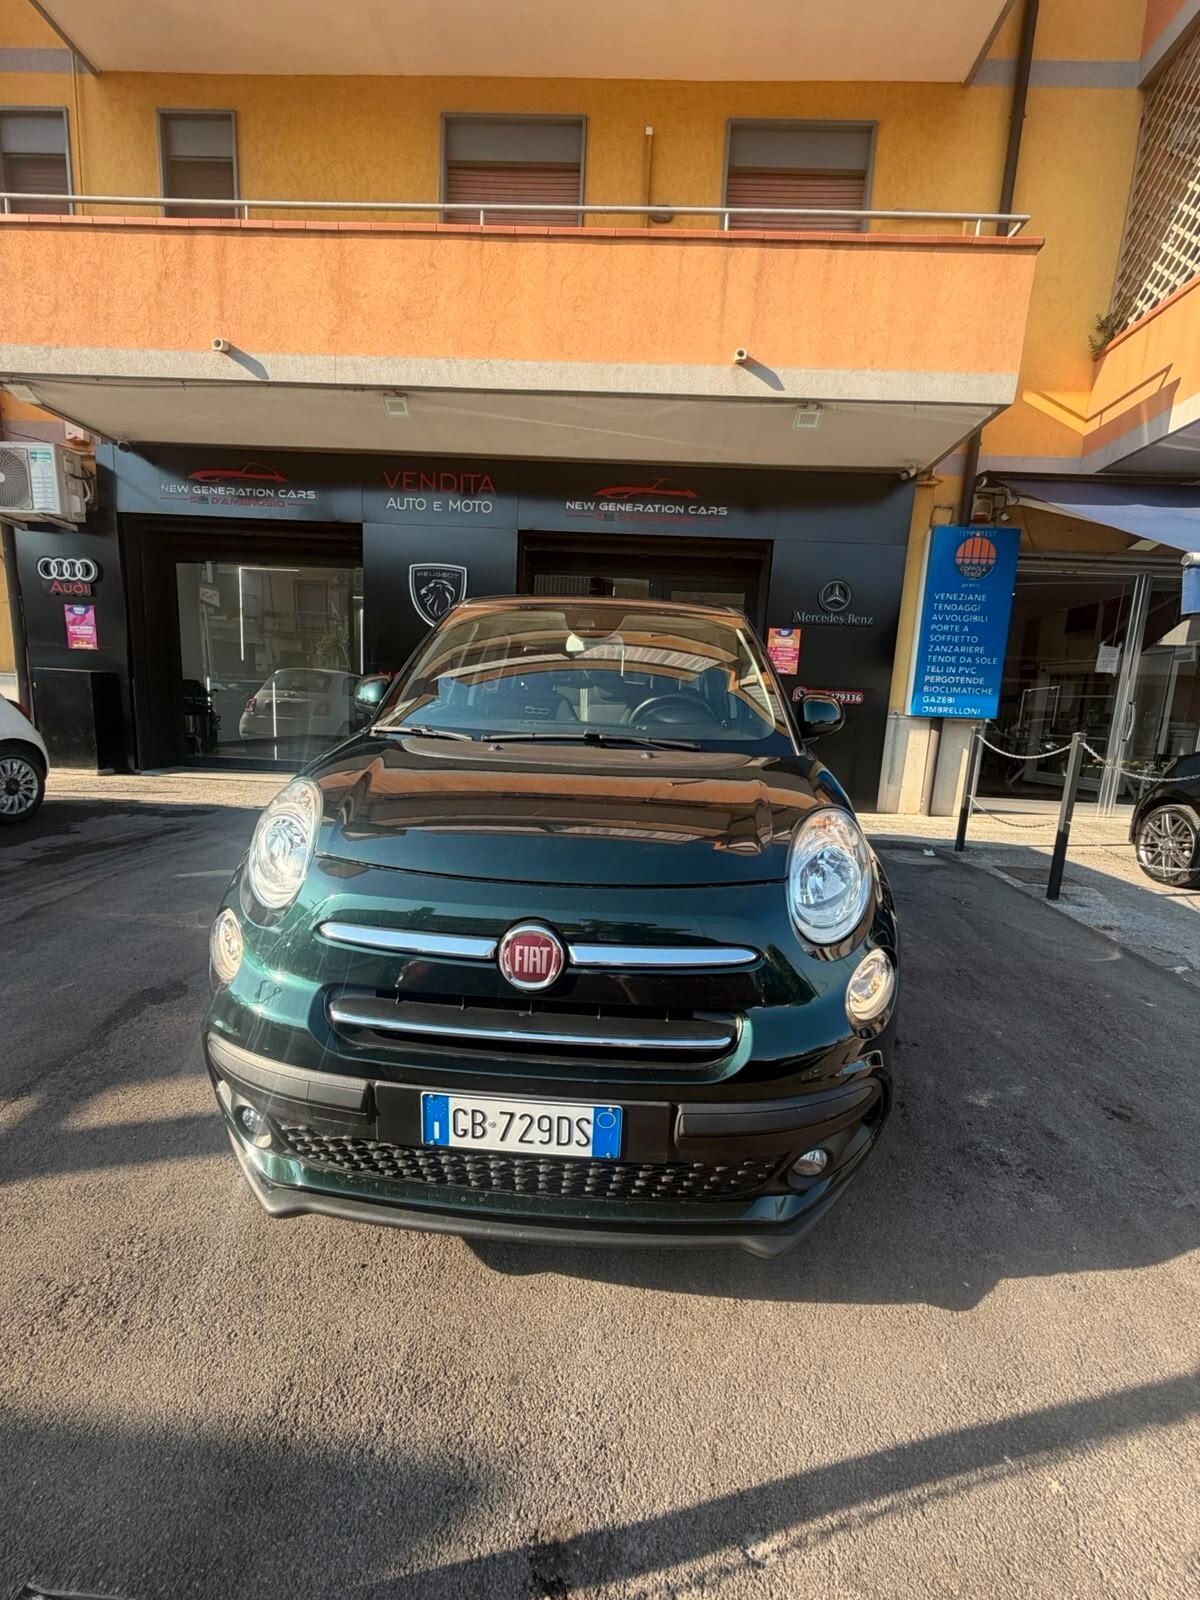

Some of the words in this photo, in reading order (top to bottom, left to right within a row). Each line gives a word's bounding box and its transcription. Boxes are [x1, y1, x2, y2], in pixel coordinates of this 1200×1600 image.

[383, 471, 496, 495] VENDITA
[160, 484, 189, 493] NEW
[192, 485, 275, 497] GENERATION
[278, 489, 317, 499] CARS
[386, 497, 427, 511] AUTO
[433, 501, 443, 511] E
[449, 499, 493, 513] MOTO
[565, 501, 595, 510] NEW
[598, 502, 684, 514] GENERATION
[688, 505, 728, 515] CARS
[417, 571, 459, 579] PEUGEOT
[50, 581, 89, 594] Audi
[934, 592, 988, 601] VENEZIANE
[933, 603, 982, 612] TENDAGGI
[794, 611, 874, 625] Mercedes-Benz
[931, 614, 988, 623] AVVOLGIBILI
[930, 624, 961, 633] PORTE
[929, 634, 979, 643] SOFFIETTO
[928, 645, 985, 654] ZANZARIERE
[928, 655, 957, 663] TENDE
[959, 656, 972, 664] DA
[975, 657, 999, 665] SOLE
[926, 665, 944, 673] TELI
[959, 666, 977, 674] PVC
[924, 675, 985, 685] PERGOTENDE
[923, 685, 994, 695] BIOCLIMATICHE
[922, 696, 956, 704] GAZEBI
[921, 706, 982, 715] OMBRELLONI
[515, 944, 551, 974] FIAT
